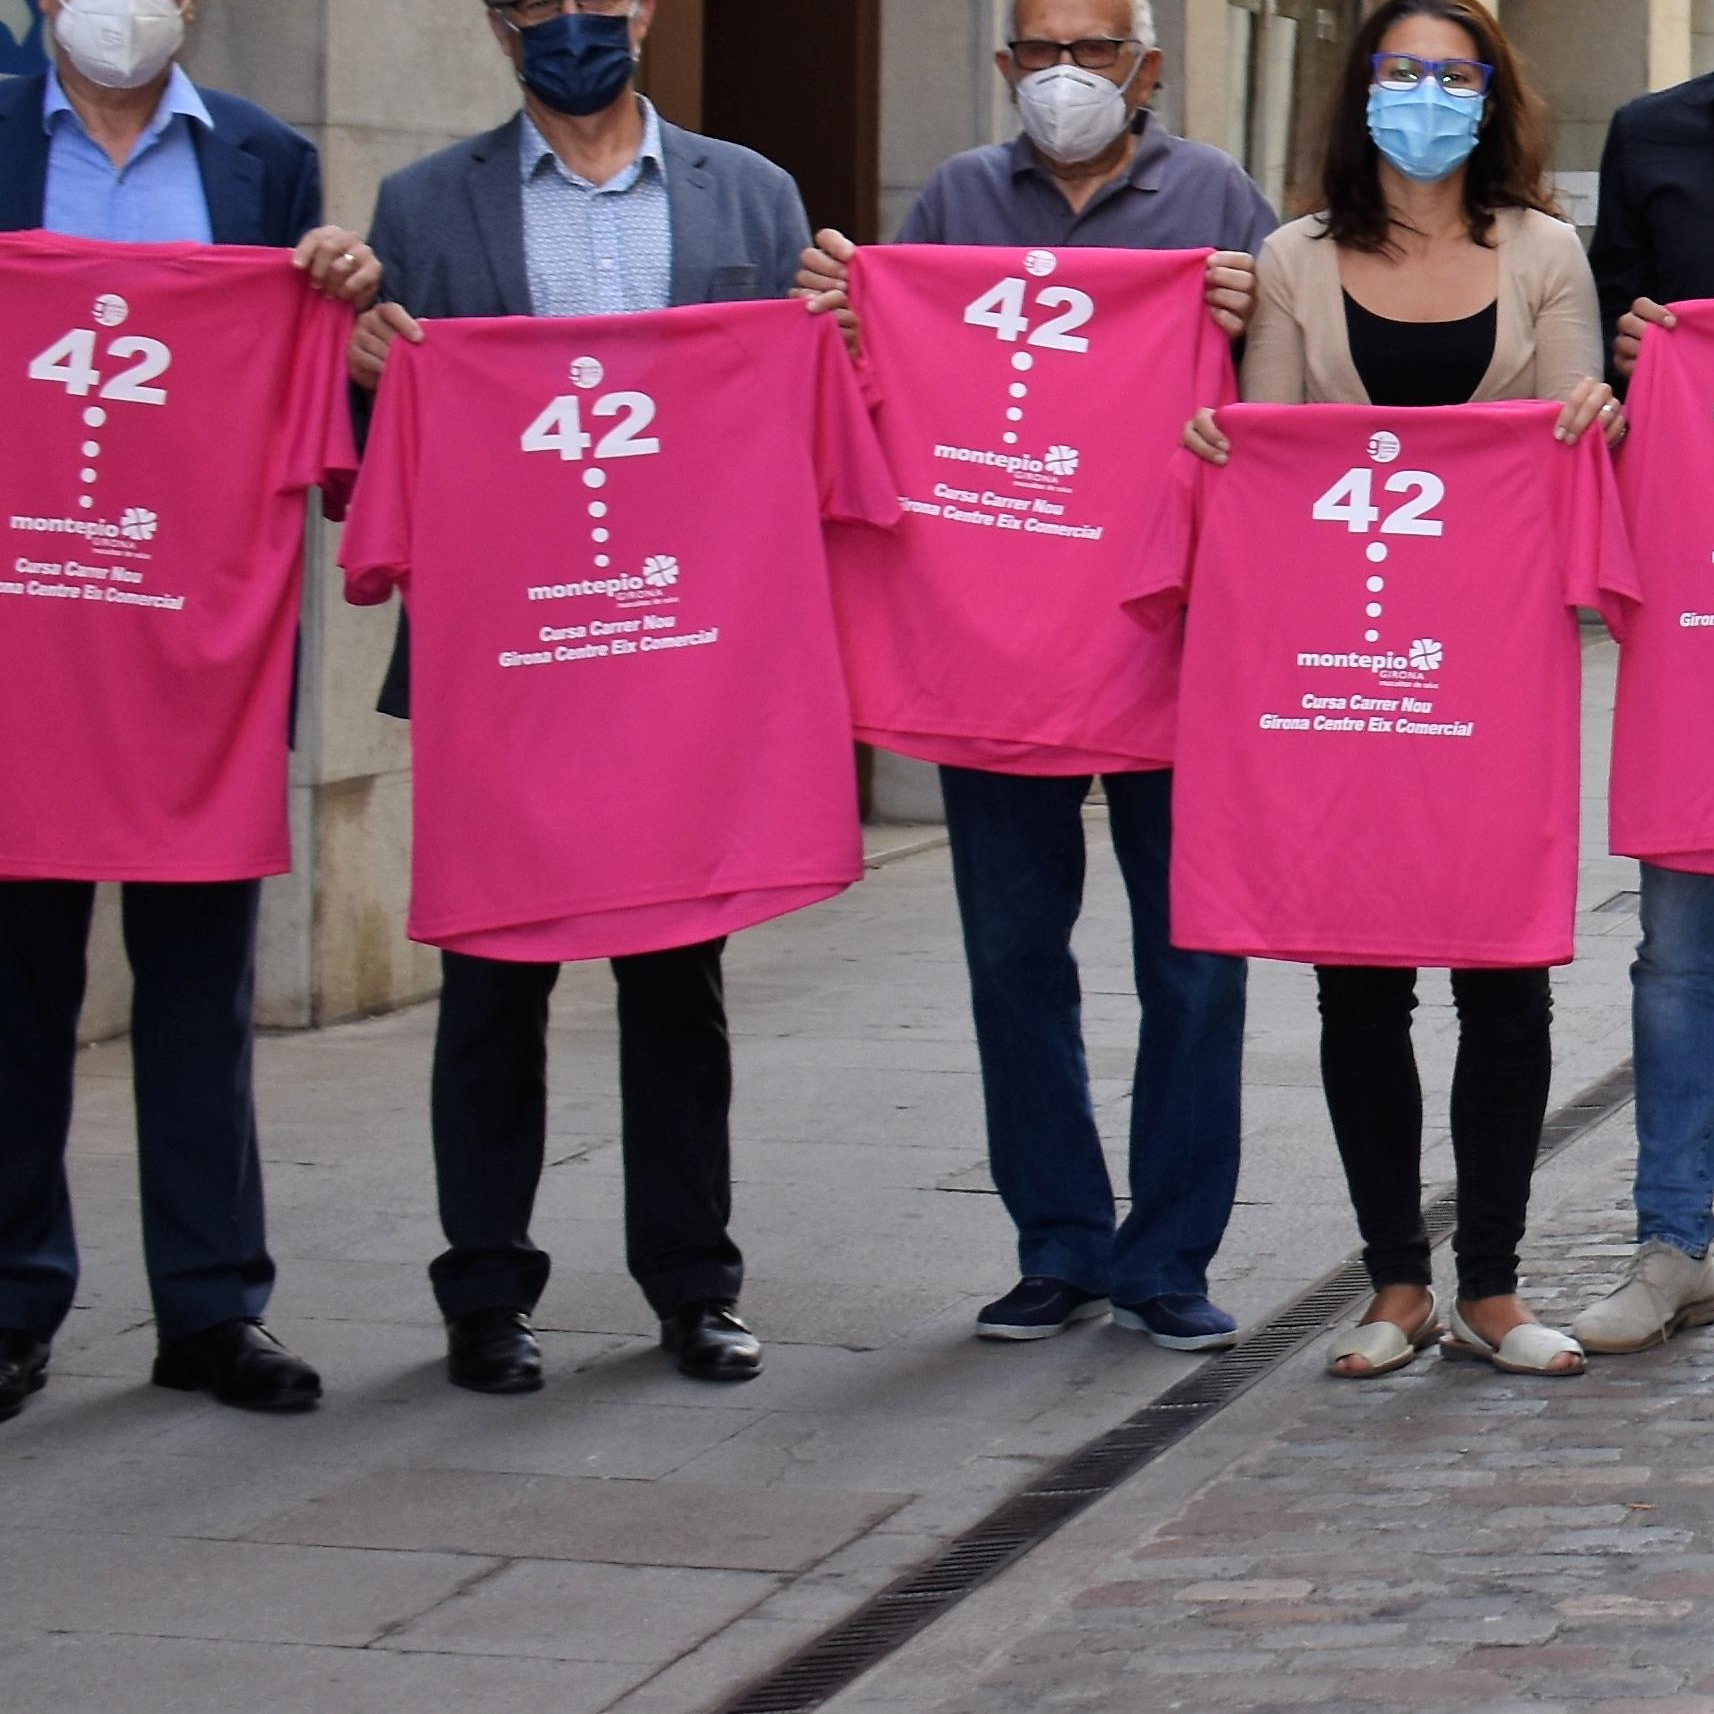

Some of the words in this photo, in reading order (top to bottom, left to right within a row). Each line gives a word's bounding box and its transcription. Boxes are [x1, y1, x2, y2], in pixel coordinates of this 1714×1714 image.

[963, 276, 1095, 353] 42
[28, 329, 172, 405] 42
[520, 391, 660, 461] 42
[933, 444, 1043, 474] montepio
[933, 483, 979, 503] Cursa
[981, 491, 1031, 512] Carrer
[1032, 498, 1065, 516] Nou
[1312, 467, 1445, 537] 42
[942, 505, 995, 526] Centre
[997, 513, 1023, 530] Eix
[1024, 518, 1104, 540] Comercial
[528, 573, 644, 601] montepio
[539, 626, 587, 642] Cursa
[590, 619, 641, 636] Carrer
[643, 614, 677, 631] Nou
[499, 652, 552, 668] Girona
[554, 644, 609, 662] Centre
[611, 639, 637, 655] Eix
[640, 627, 719, 652] Comercial
[1297, 650, 1408, 673] montepio
[1379, 670, 1424, 681] GIRONA
[1301, 693, 1347, 710] Cursa
[1349, 694, 1399, 713] Carrer
[1401, 697, 1432, 714] Nou
[1259, 713, 1310, 731] Girona
[1313, 714, 1365, 733] Centre
[1367, 717, 1393, 734] Eix
[1395, 718, 1474, 737] Comercial
